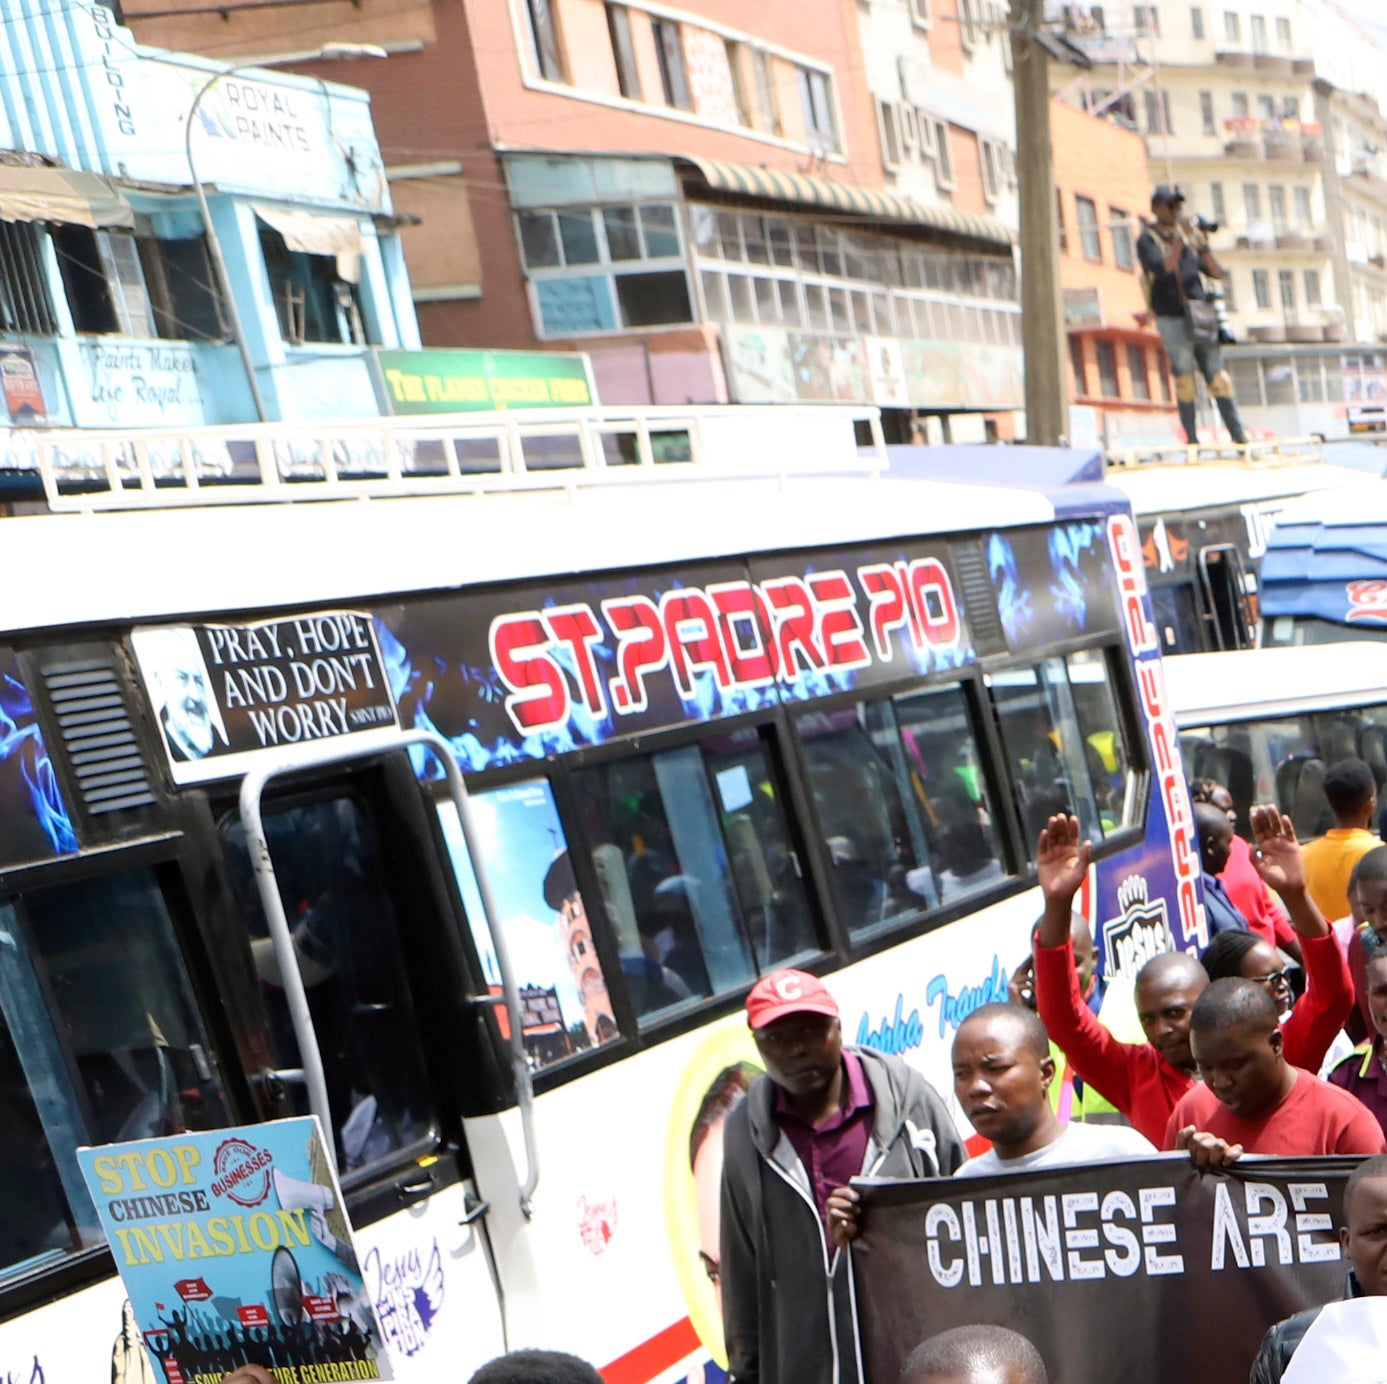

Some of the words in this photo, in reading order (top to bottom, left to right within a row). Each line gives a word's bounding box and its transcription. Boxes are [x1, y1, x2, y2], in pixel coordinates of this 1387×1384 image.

[225, 82, 298, 118] ROYAL
[235, 115, 311, 152] PAINTS
[856, 556, 961, 662] PIO
[207, 624, 296, 666] PRAY,
[294, 613, 369, 655] HOPE
[222, 665, 289, 709] AND
[288, 652, 376, 699] DON'T
[247, 696, 351, 747] WORRY
[93, 1144, 202, 1196] STOP
[210, 1149, 273, 1198] BUSINESSES
[108, 1189, 211, 1223] CHINESE
[115, 1208, 313, 1267] INVASION
[924, 1184, 1186, 1289] CHINESE
[1210, 1181, 1342, 1272] ARE
[300, 1359, 380, 1384] GENERATION
